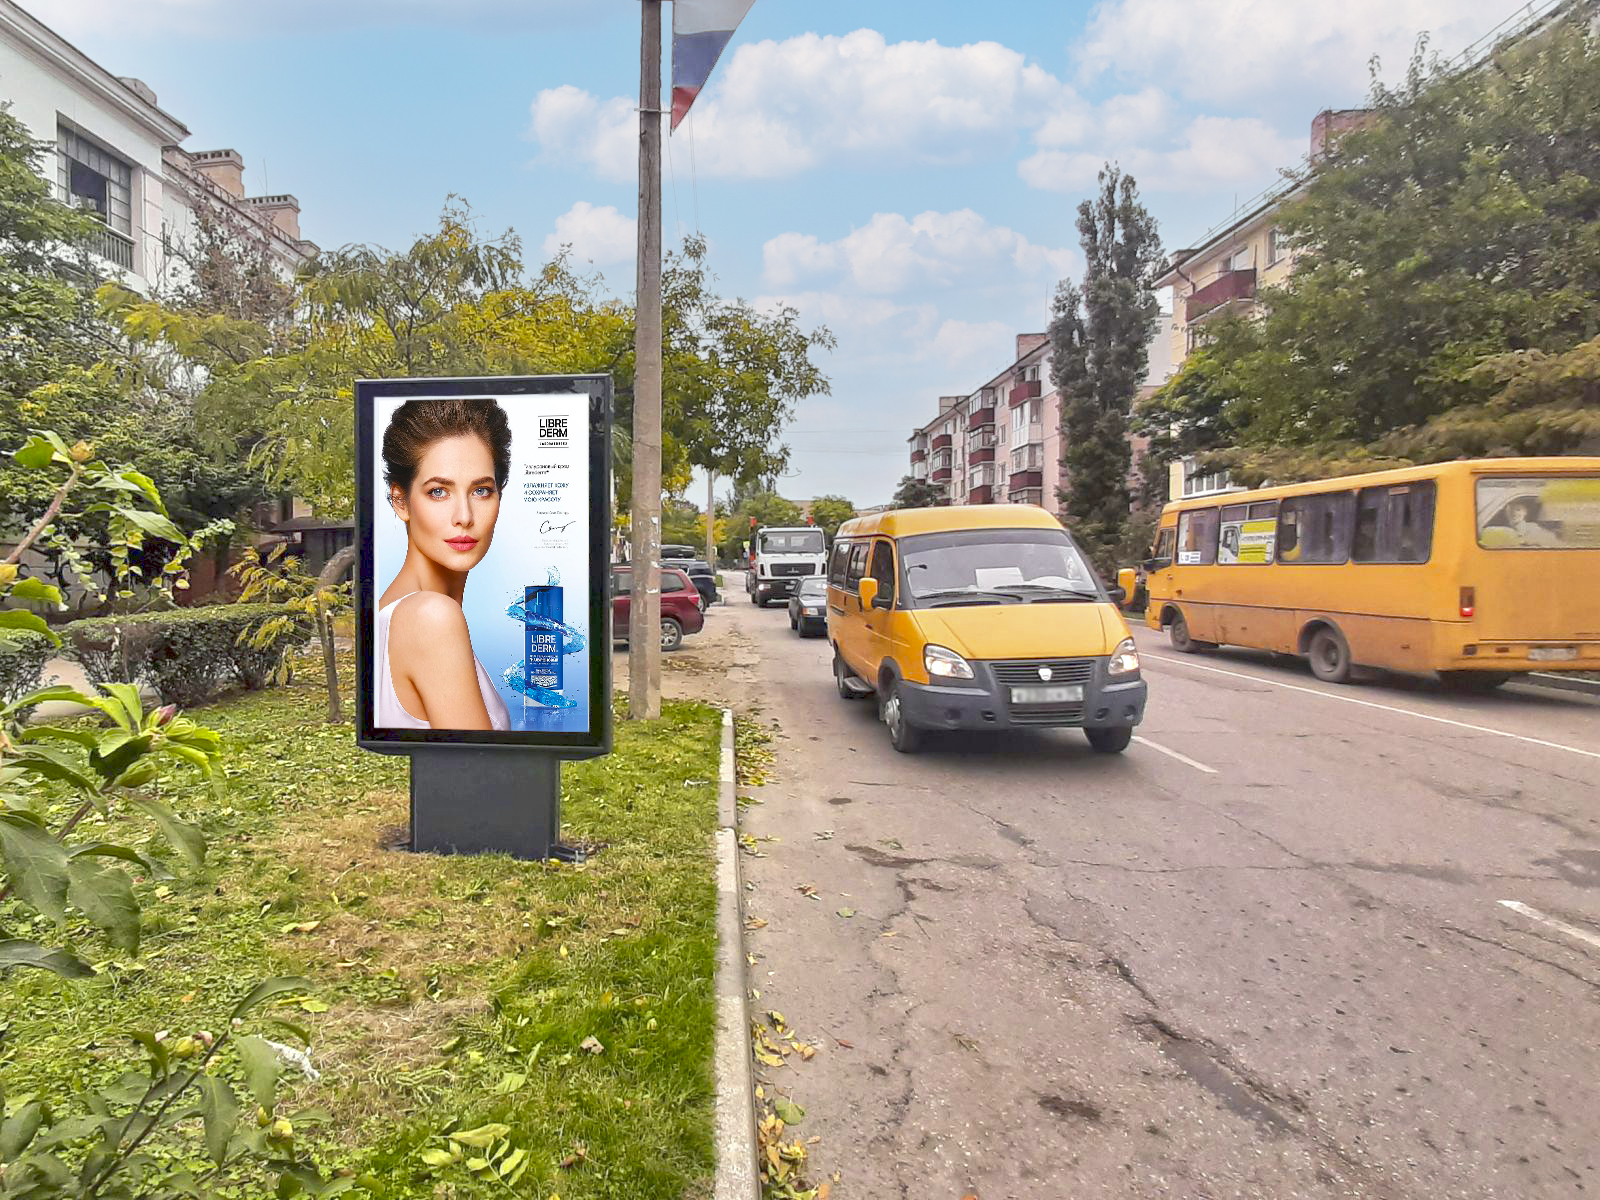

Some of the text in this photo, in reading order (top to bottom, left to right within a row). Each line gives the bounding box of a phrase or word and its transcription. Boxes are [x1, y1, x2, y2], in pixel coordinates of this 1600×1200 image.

[539, 418, 568, 428] LIBRE
[539, 428, 568, 438] DERM
[531, 634, 557, 643] LIBRE
[531, 644, 556, 652] DERM
